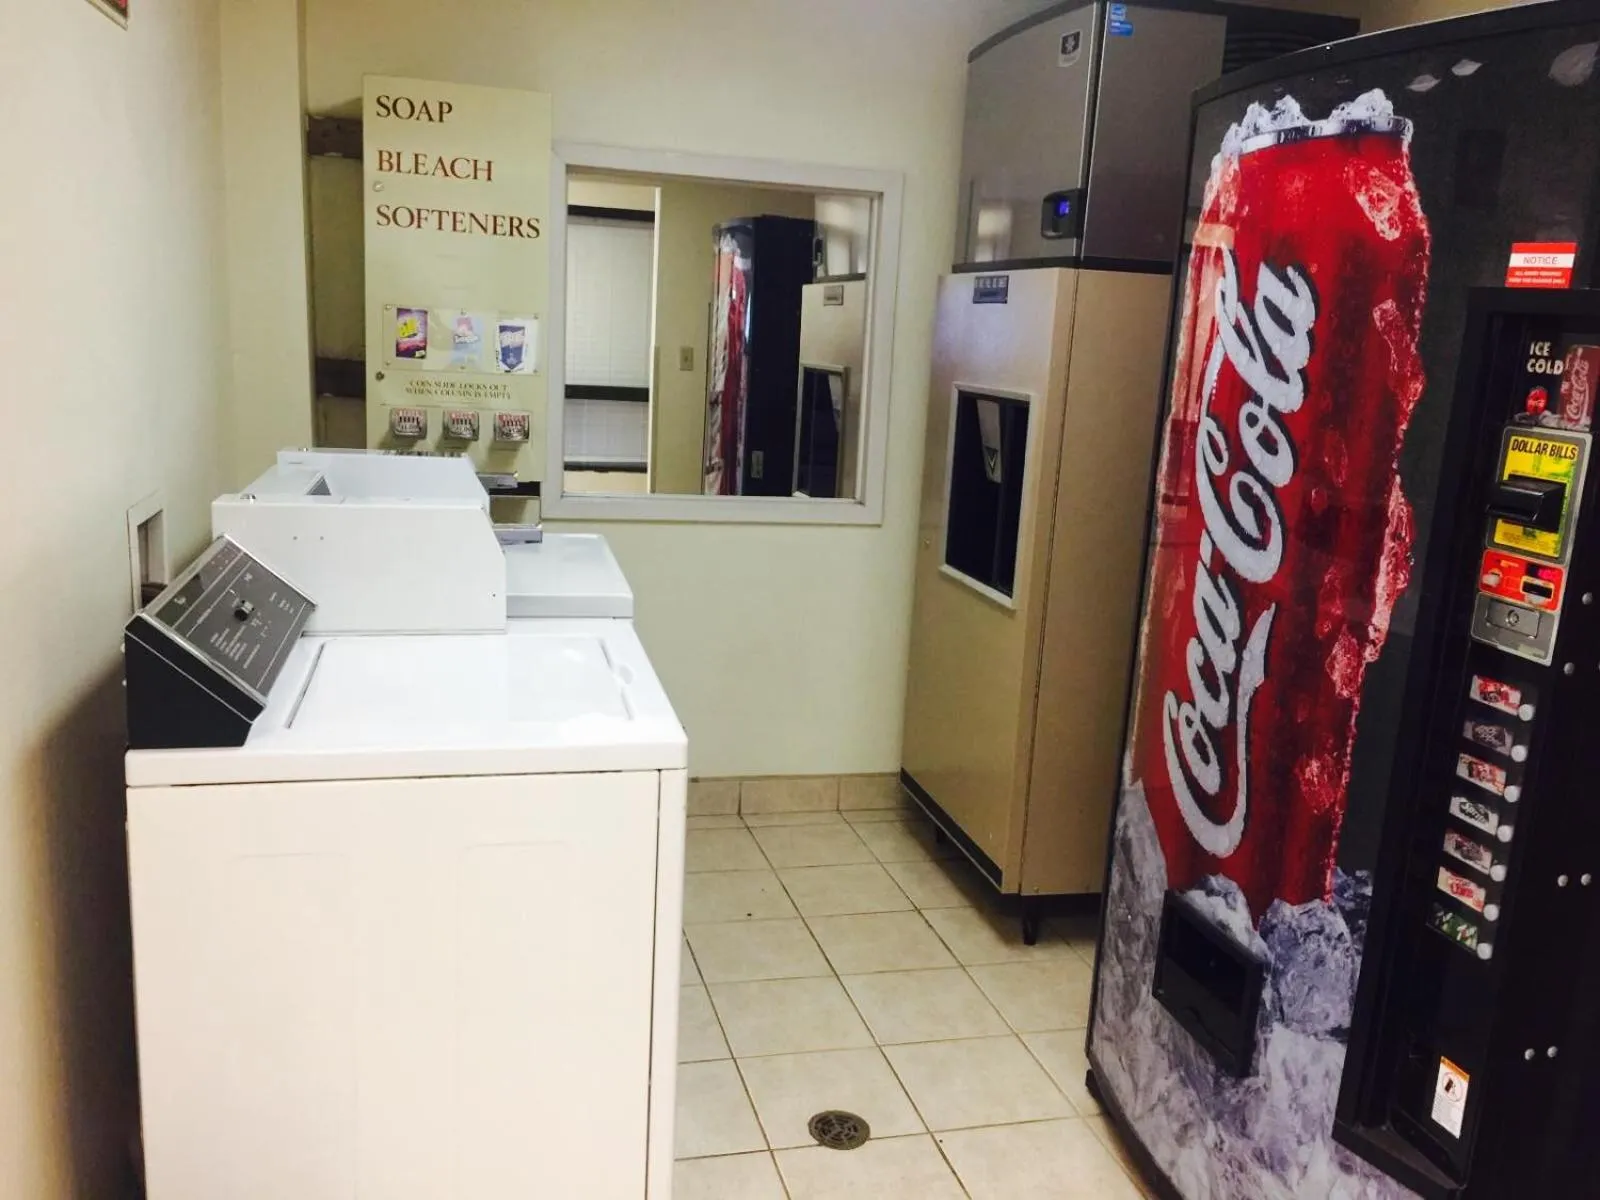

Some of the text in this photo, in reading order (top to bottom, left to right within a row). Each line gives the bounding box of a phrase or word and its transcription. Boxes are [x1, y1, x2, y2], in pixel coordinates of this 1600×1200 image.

[376, 95, 453, 123] SOAP
[376, 150, 494, 182] BLEACH
[376, 204, 540, 239] SOFTENERS
[1522, 256, 1559, 265] NOTICE
[1529, 341, 1552, 357] ICE
[1526, 358, 1564, 375] COLD
[1511, 439, 1577, 461] DOLLAR BILLS
[1163, 243, 1315, 858] Coca-Cola
